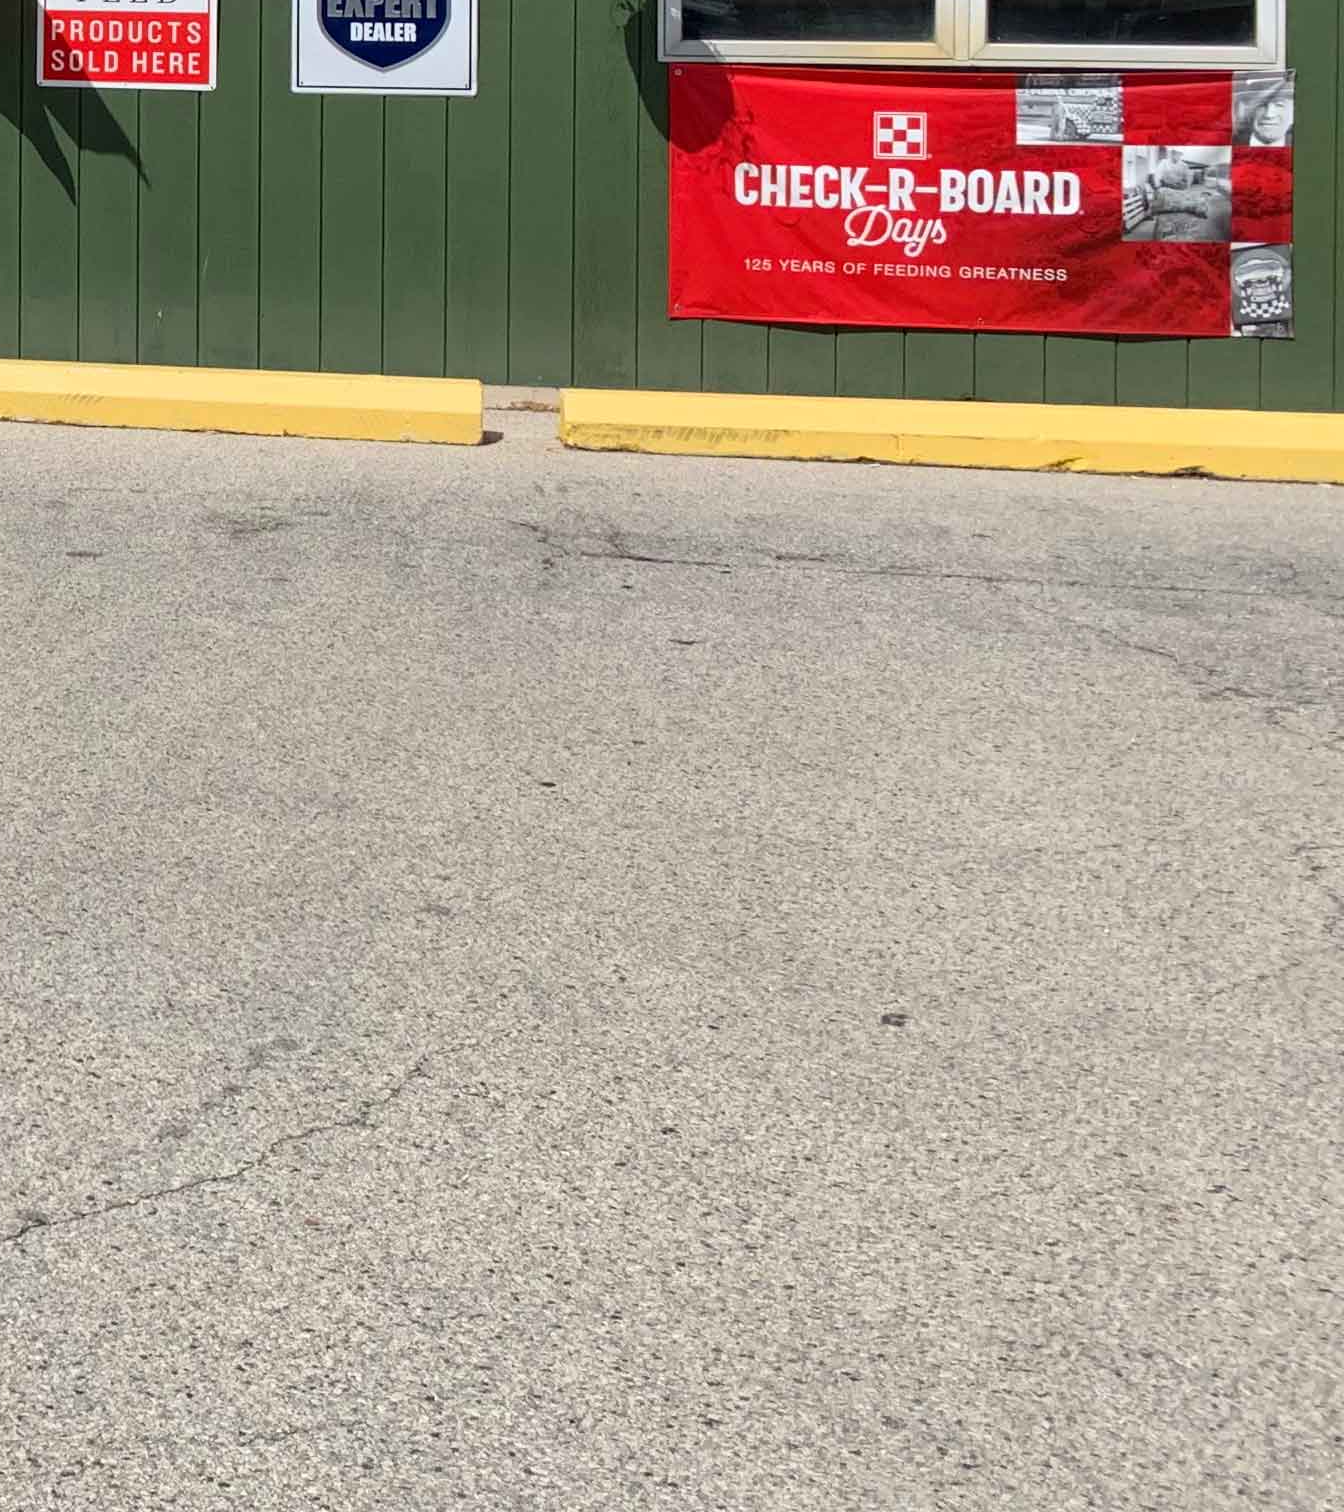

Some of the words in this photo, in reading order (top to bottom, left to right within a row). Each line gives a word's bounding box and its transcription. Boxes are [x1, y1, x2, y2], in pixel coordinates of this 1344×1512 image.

[51, 18, 202, 44] PRODUCTS
[350, 22, 417, 43] DEALER
[51, 50, 119, 74] SOLD
[131, 51, 201, 76] HERE
[734, 162, 1081, 216] CHECK-R-BOARD
[844, 204, 947, 257] Days
[744, 258, 772, 272] 125
[779, 260, 836, 274] YEARS
[843, 262, 866, 275] OF
[873, 263, 951, 279] FEEDING
[959, 265, 1068, 282] GREATNESS
